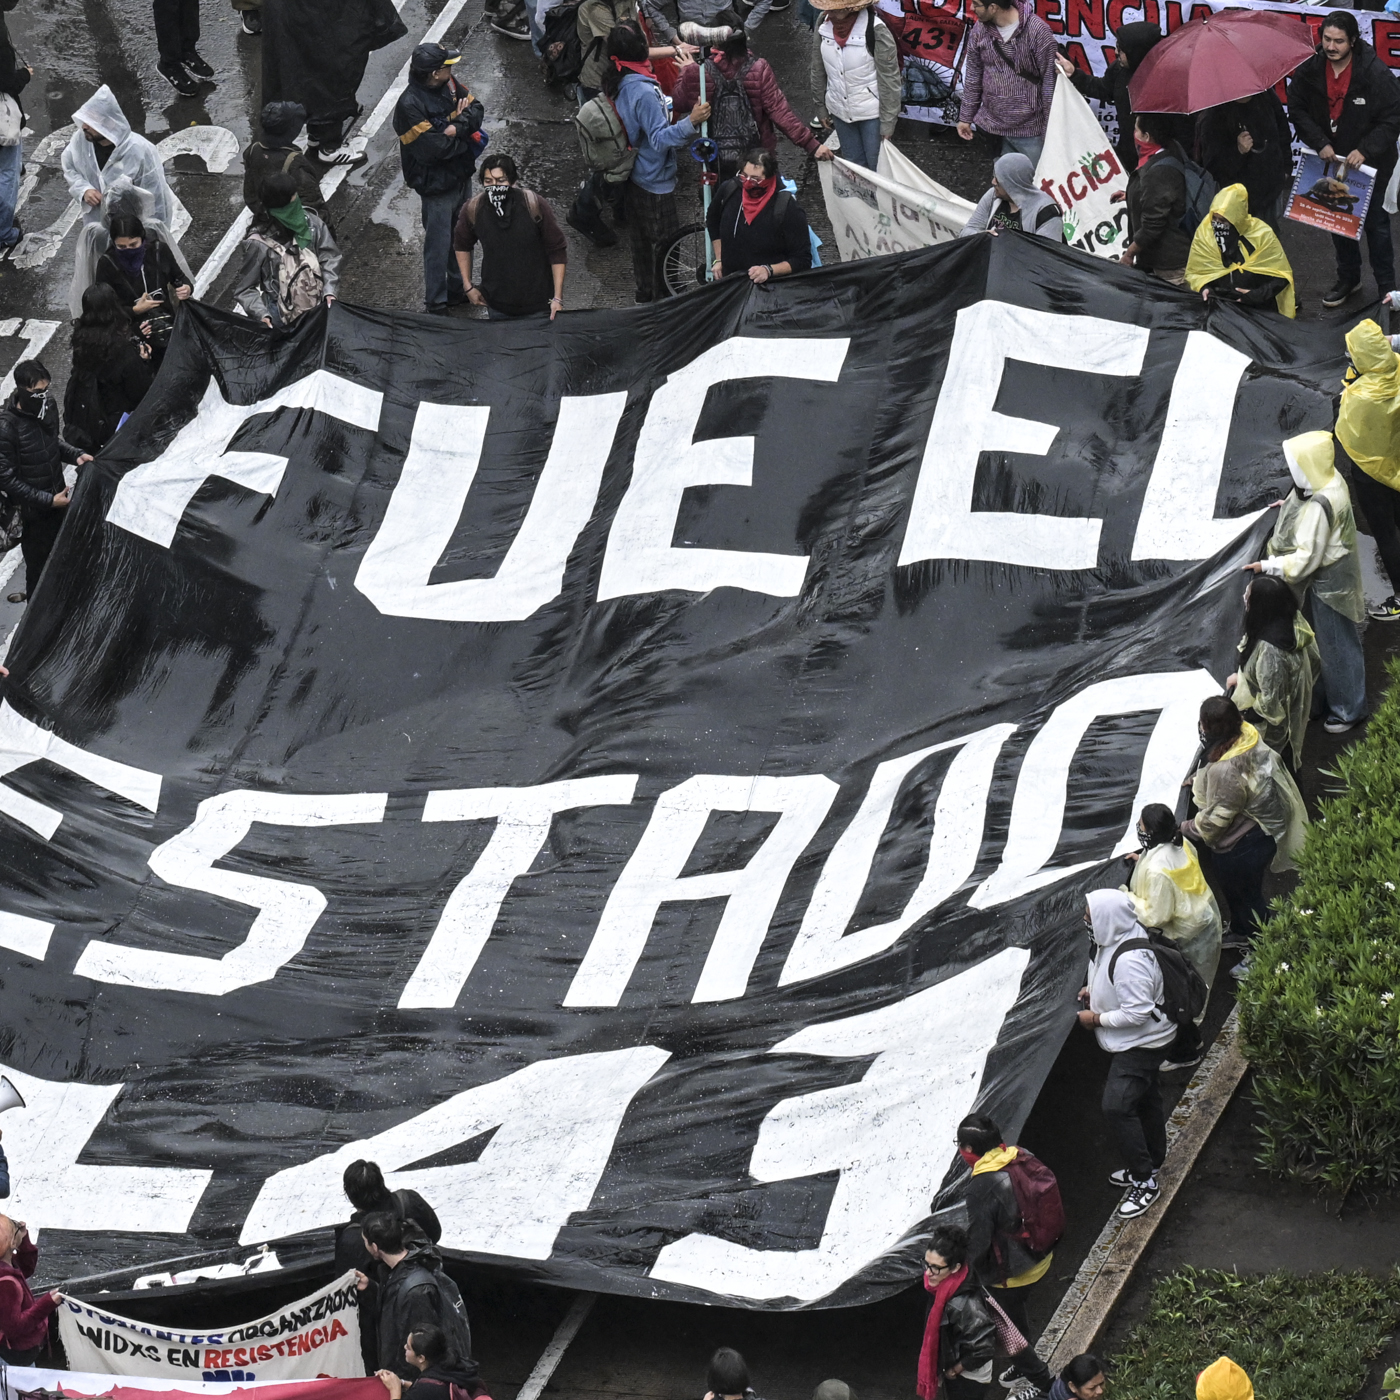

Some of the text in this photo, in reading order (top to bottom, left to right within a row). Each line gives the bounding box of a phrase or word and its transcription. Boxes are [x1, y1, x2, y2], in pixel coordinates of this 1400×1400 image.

[902, 27, 959, 51] 43!
[106, 298, 1280, 622] FUE EL
[167, 1348, 200, 1369] EN
[204, 1318, 349, 1369] RESISTENCIA
